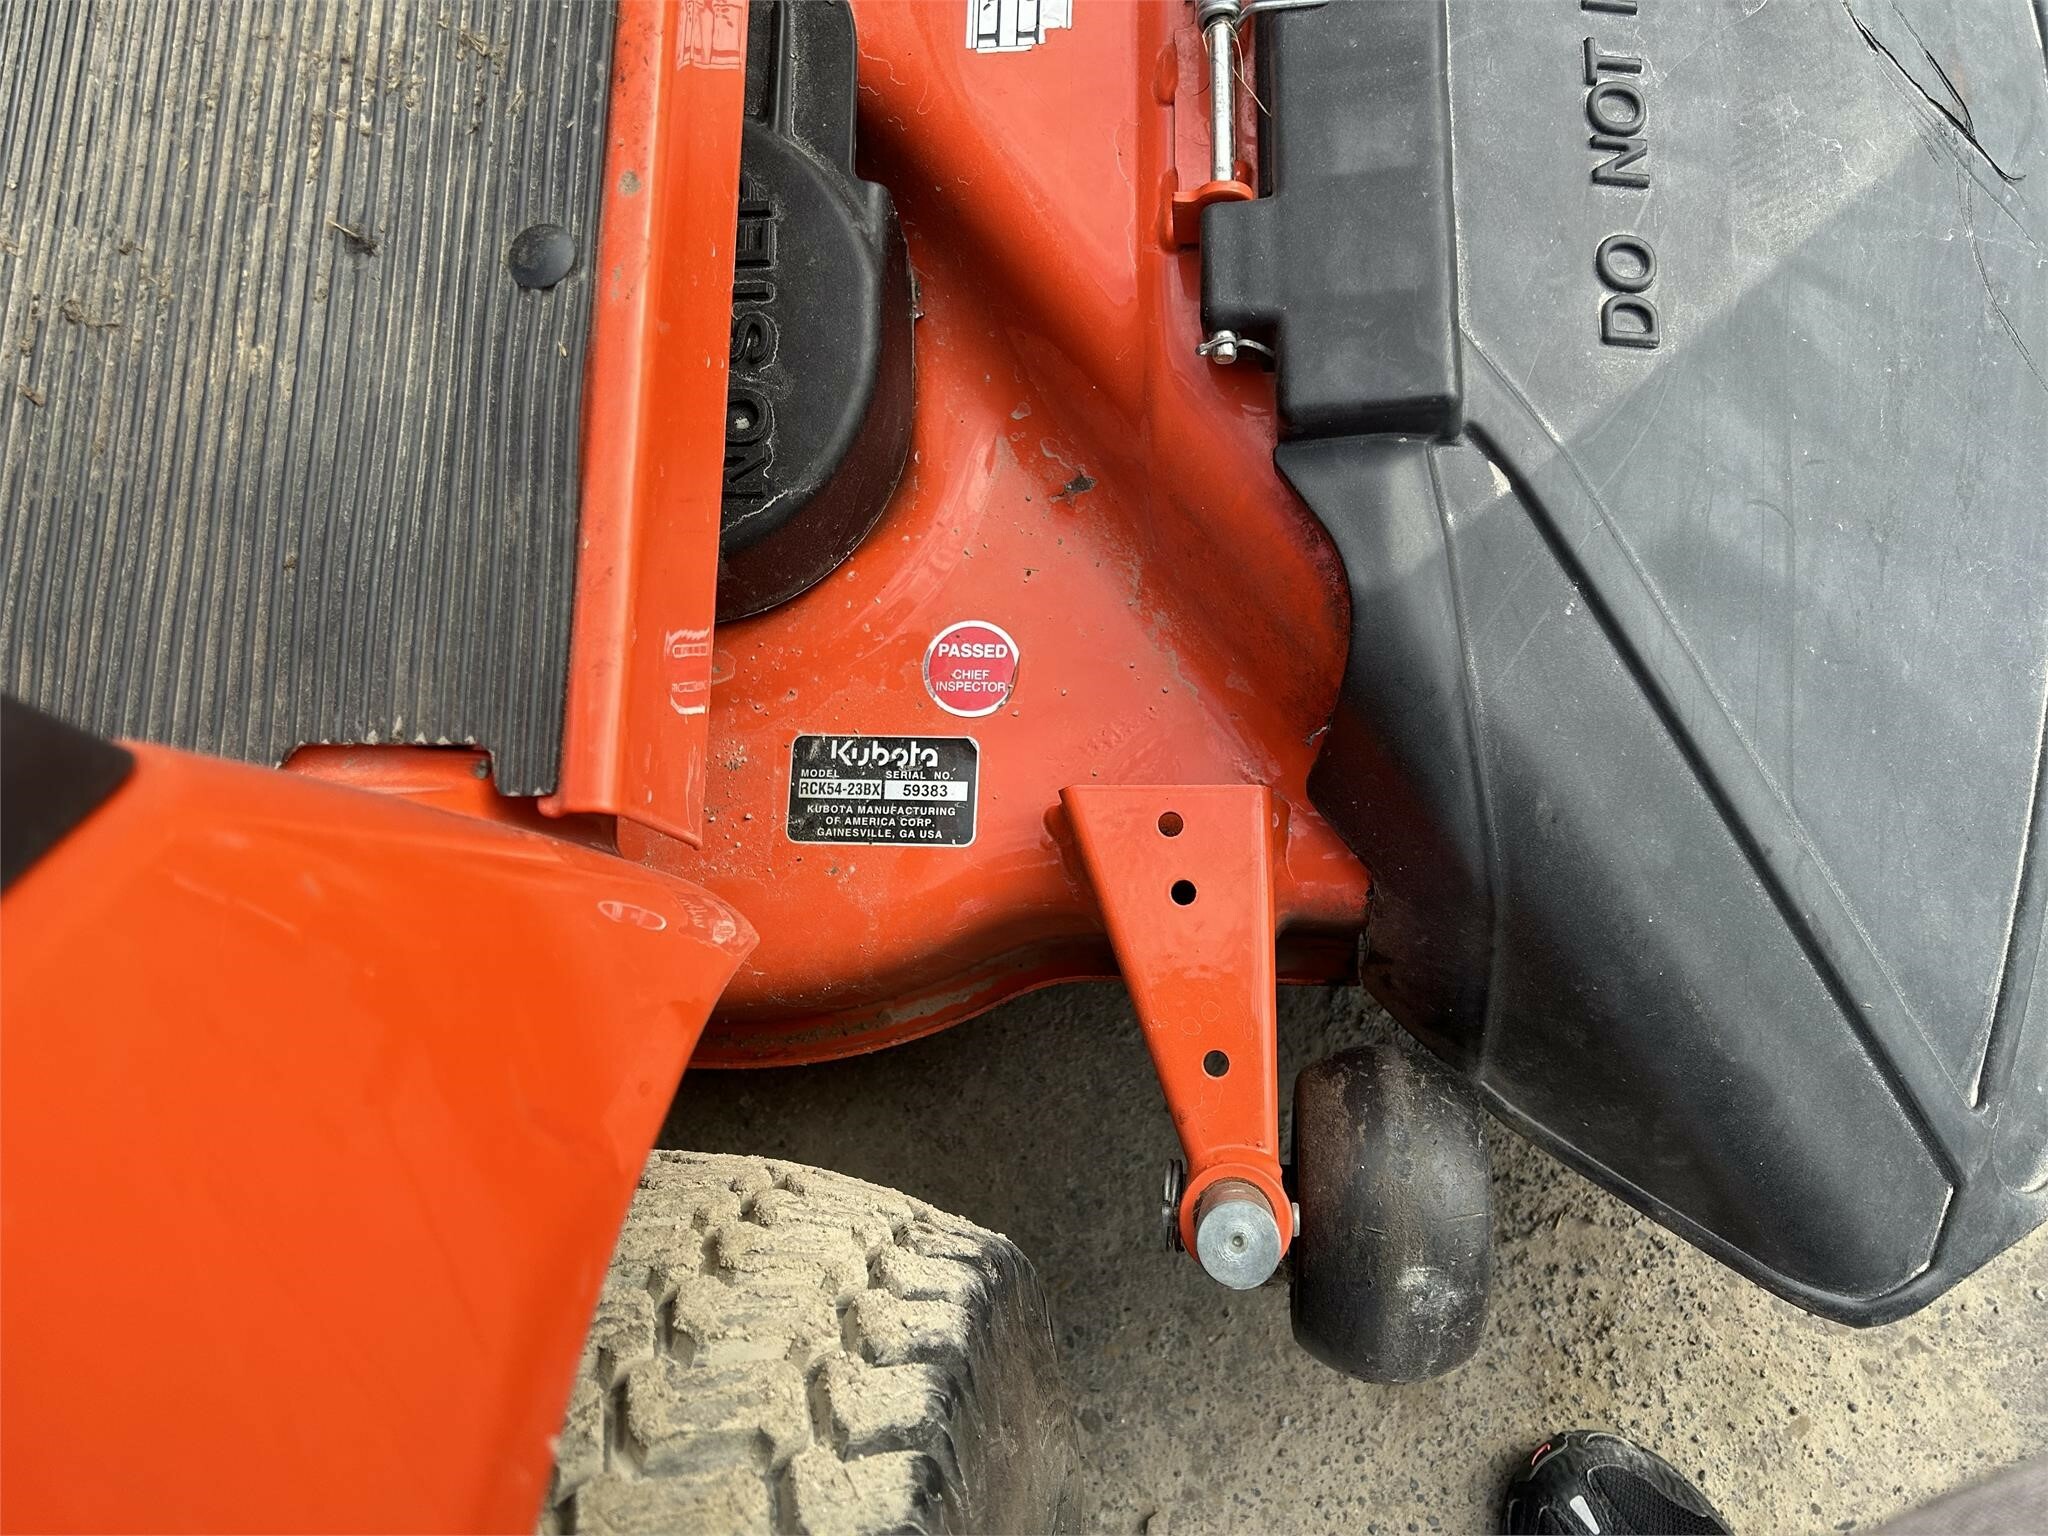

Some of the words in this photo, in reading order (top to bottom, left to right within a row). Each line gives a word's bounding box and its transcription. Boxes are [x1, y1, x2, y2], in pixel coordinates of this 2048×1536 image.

[1583, 36, 1650, 189] NOT
[1595, 234, 1660, 349] DO
[938, 643, 1008, 658] PASSED
[953, 669, 990, 680] CHIEF
[935, 681, 1006, 692] INSPECTOR
[830, 739, 939, 767] Kubota
[801, 769, 840, 778] MODEL
[885, 770, 926, 780] SERIAL
[934, 771, 954, 780] NO.
[800, 782, 881, 796] RCK54-23BX
[902, 784, 948, 798] 59383
[806, 804, 854, 814] KUBOTA
[857, 804, 956, 816] MANUFACTURING
[825, 816, 840, 825] OF
[844, 816, 896, 827] AMERICA
[900, 818, 935, 828] CORP.
[816, 828, 895, 839] GAINESVILLE,
[899, 830, 915, 839] GA
[919, 829, 943, 840] USA
